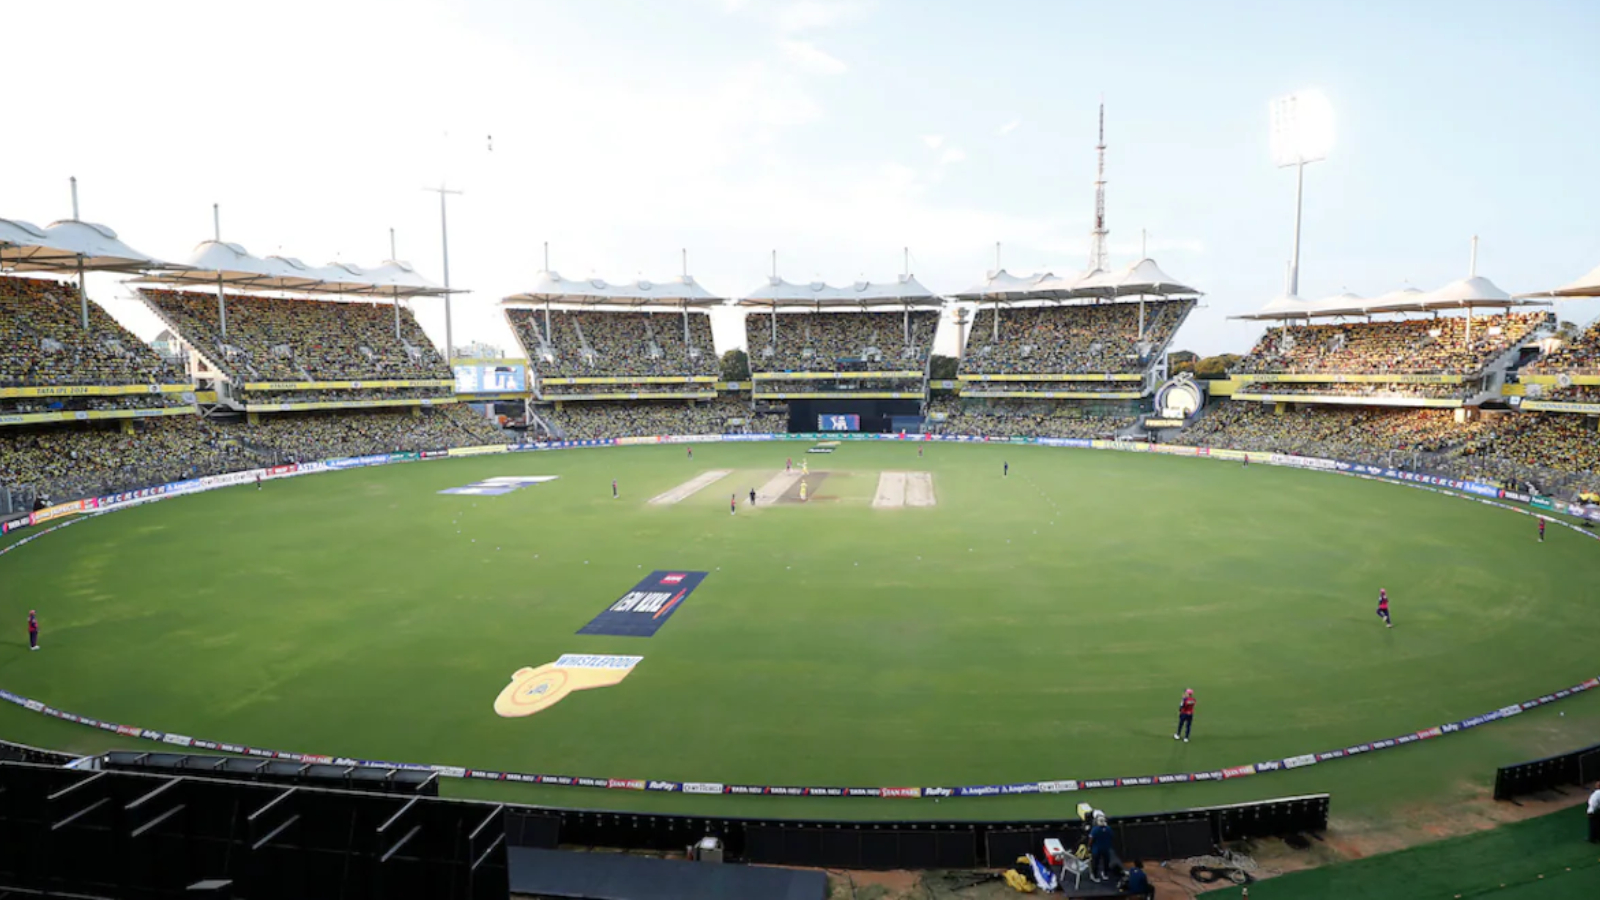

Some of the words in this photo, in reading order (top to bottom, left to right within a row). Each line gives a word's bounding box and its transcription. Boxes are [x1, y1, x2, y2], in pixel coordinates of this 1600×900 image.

[648, 780, 675, 791] RuPay
[967, 785, 1000, 796] AngelOne
[925, 786, 951, 797] RuPay
